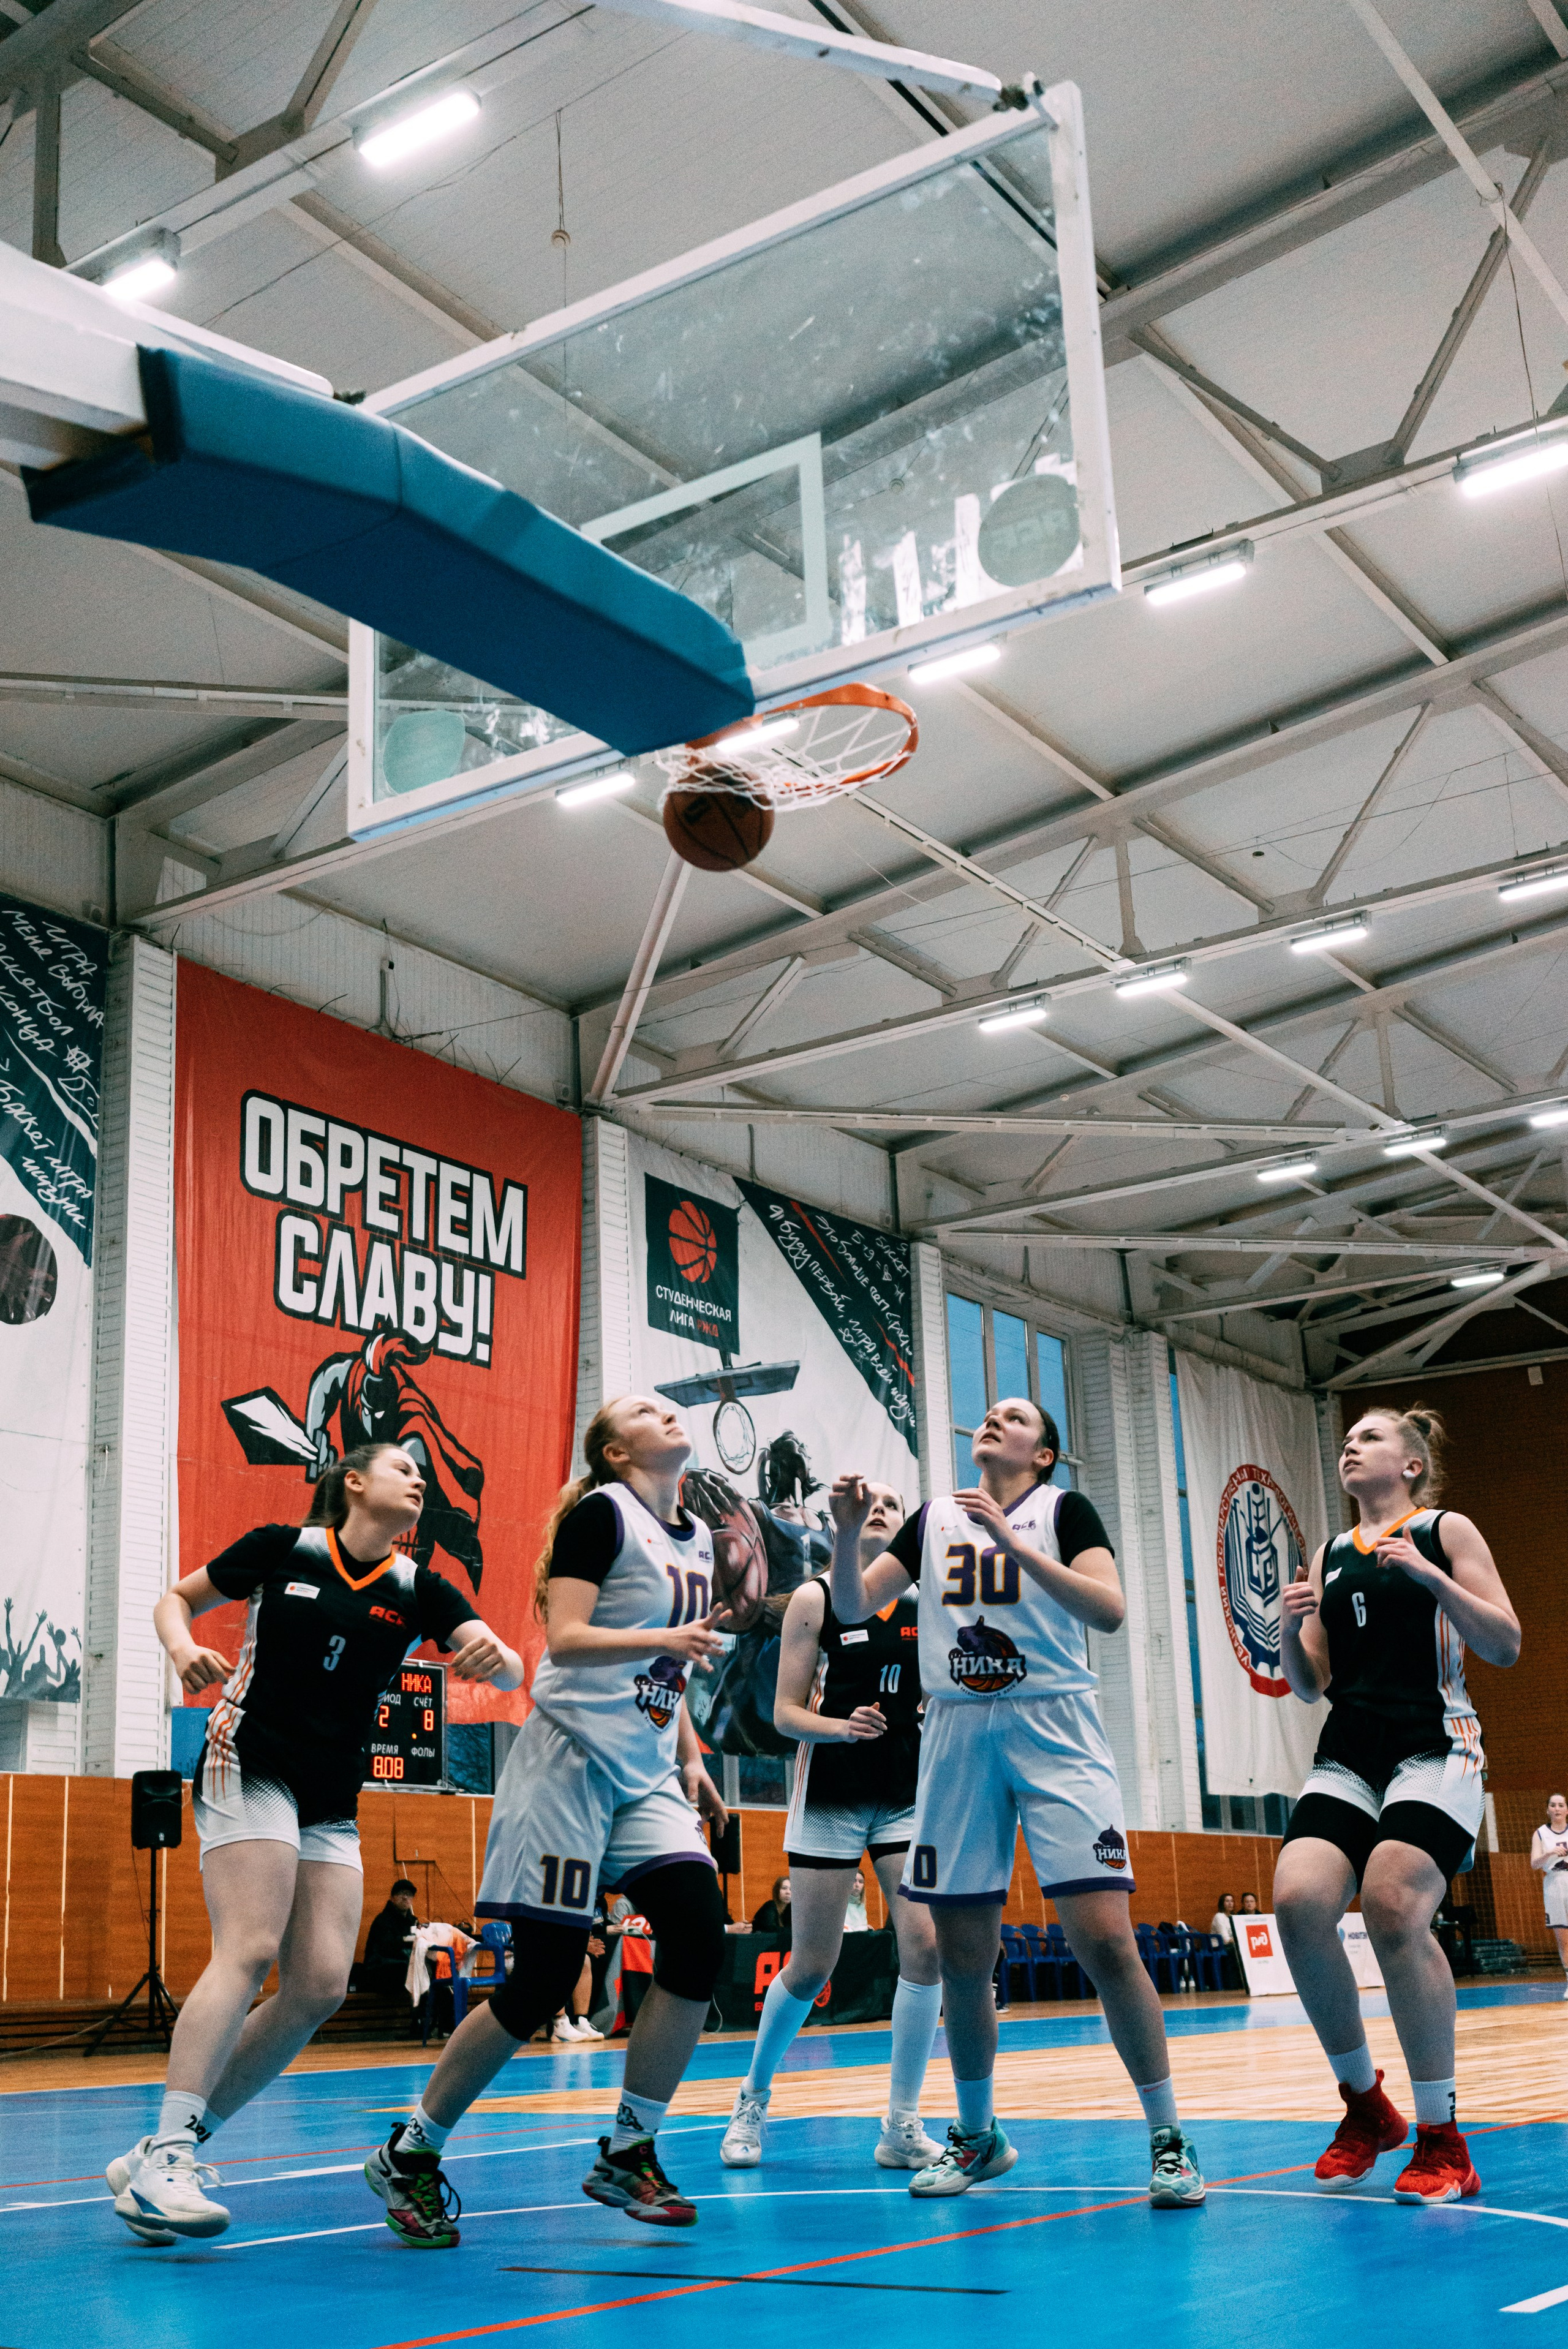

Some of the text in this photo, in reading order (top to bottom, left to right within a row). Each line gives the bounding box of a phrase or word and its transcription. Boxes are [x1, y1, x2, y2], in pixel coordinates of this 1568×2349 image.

[245, 1096, 524, 1273] ОБРЕТЕМ
[278, 1215, 491, 1362] СЛАВУ!
[655, 1284, 732, 1322] СТУДЕНЧЕСКАЯ
[669, 1310, 695, 1329] ЛИГА
[941, 1542, 1022, 1607] 30
[665, 1563, 709, 1629] 10
[1352, 1592, 1367, 1627] 6
[323, 1635, 347, 1672] 3
[952, 1655, 1025, 1681] НИКА
[401, 1672, 432, 1694] НИКА
[879, 1664, 902, 1694] 10
[638, 1684, 681, 1711] НИК
[379, 1705, 434, 1732] 2 8
[371, 1743, 435, 1757] ВРЕМЯ ФОЛЫ
[540, 1855, 592, 1910] 10
[911, 1844, 938, 1890] 0
